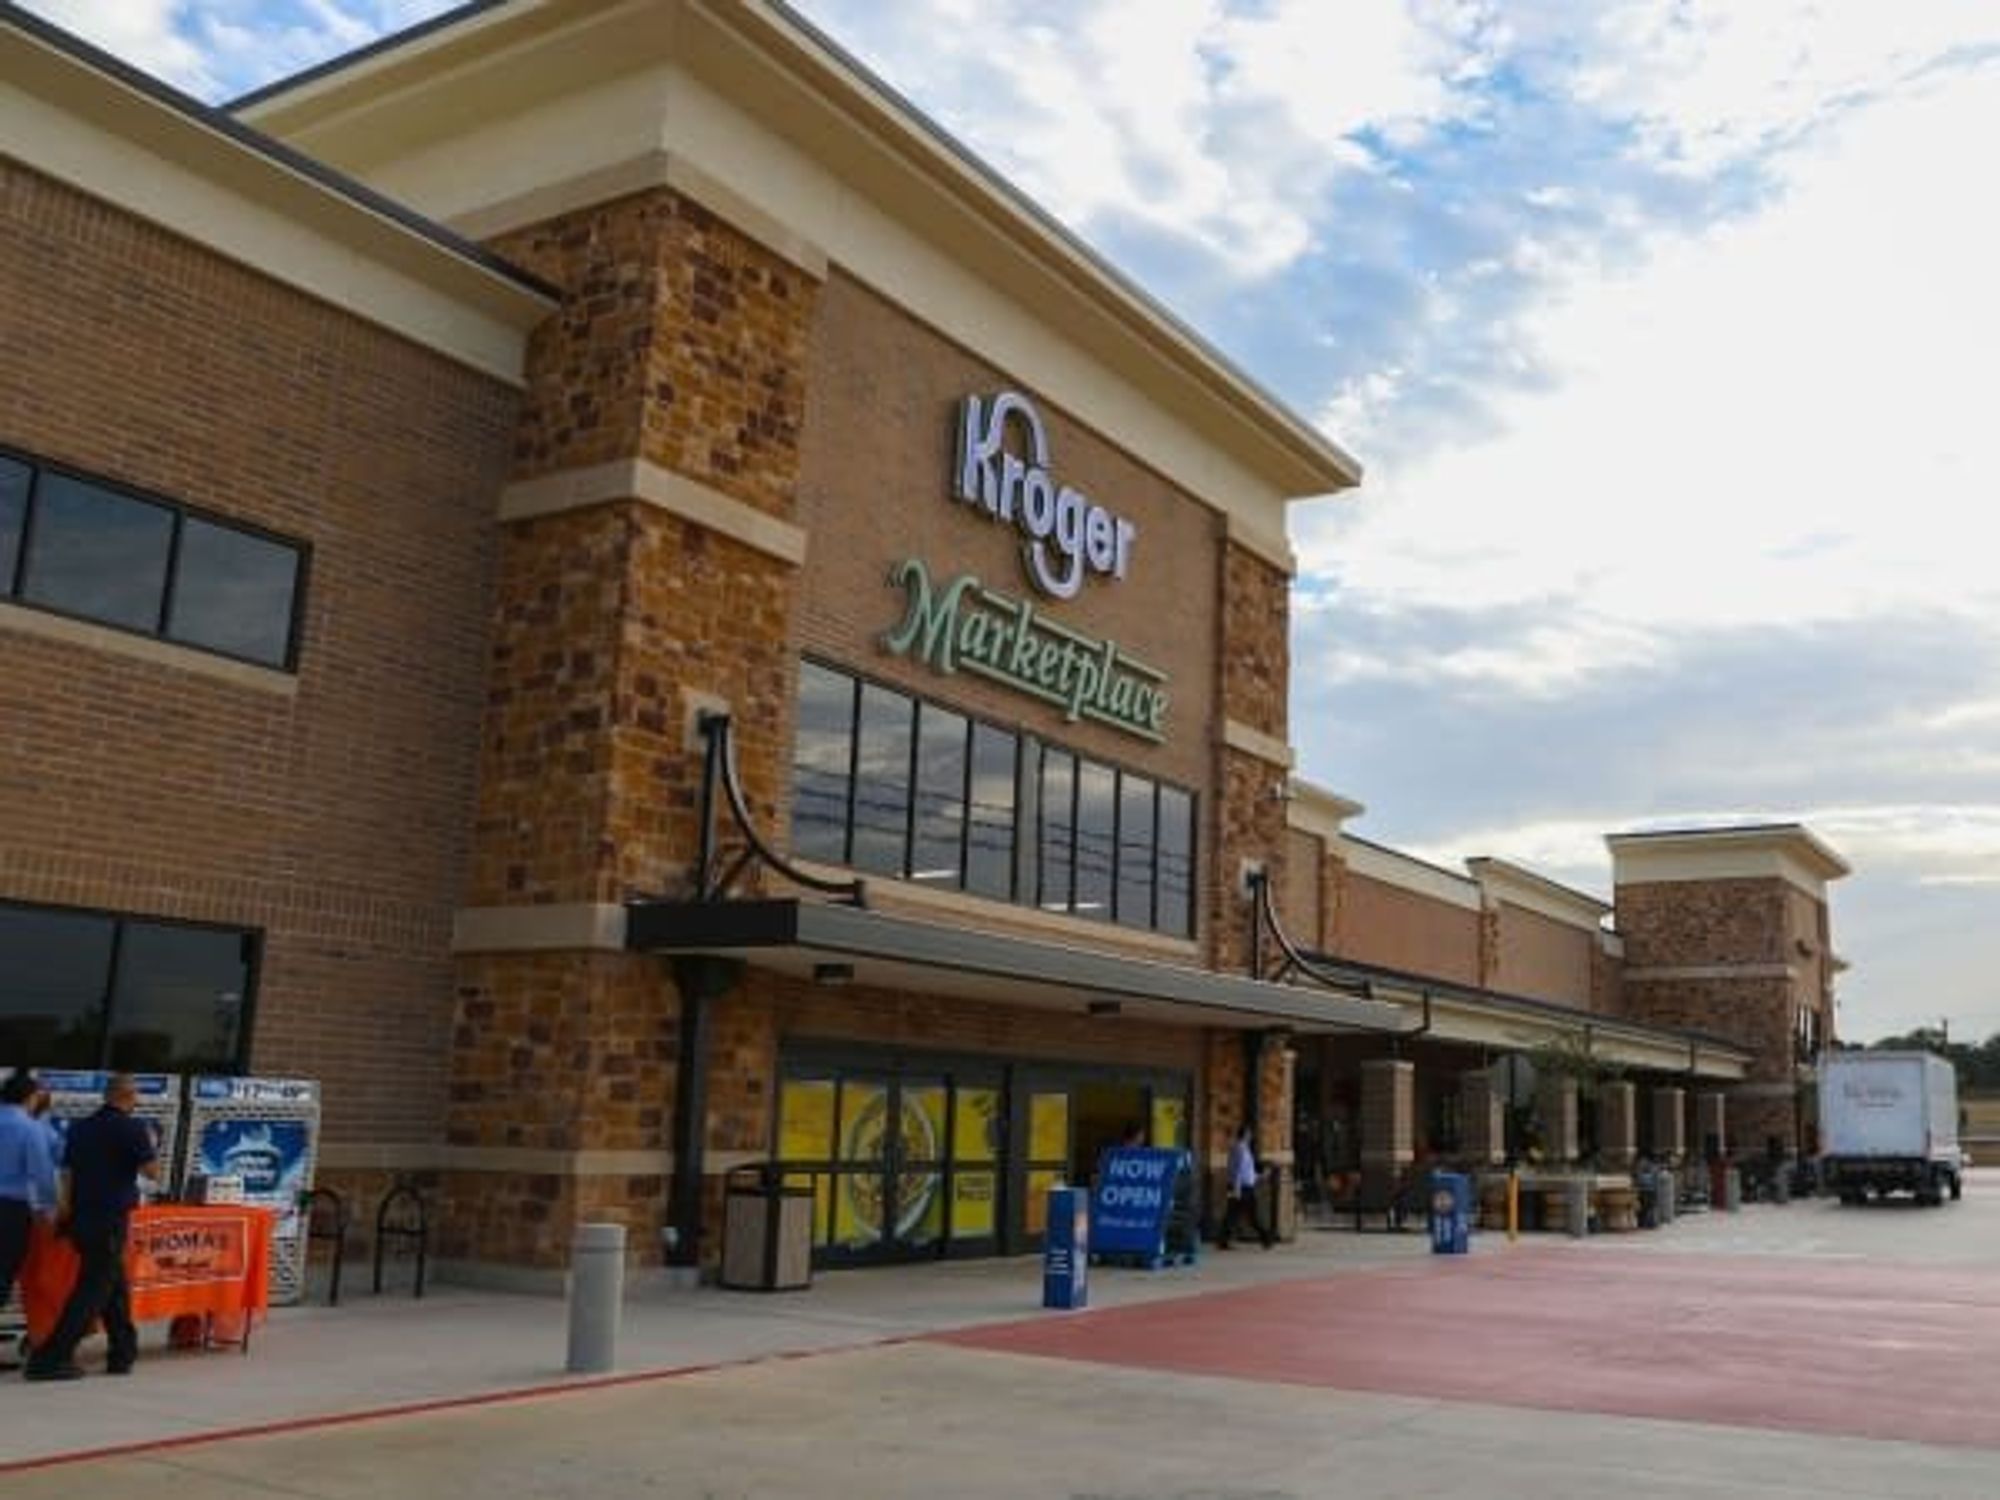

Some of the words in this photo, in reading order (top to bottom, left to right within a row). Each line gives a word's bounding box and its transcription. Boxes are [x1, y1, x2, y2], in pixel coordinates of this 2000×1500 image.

[961, 392, 1136, 598] Kroger
[887, 559, 1170, 727] Marketplace
[1102, 1186, 1161, 1206] OPEN
[1110, 1159, 1166, 1178] NOW
